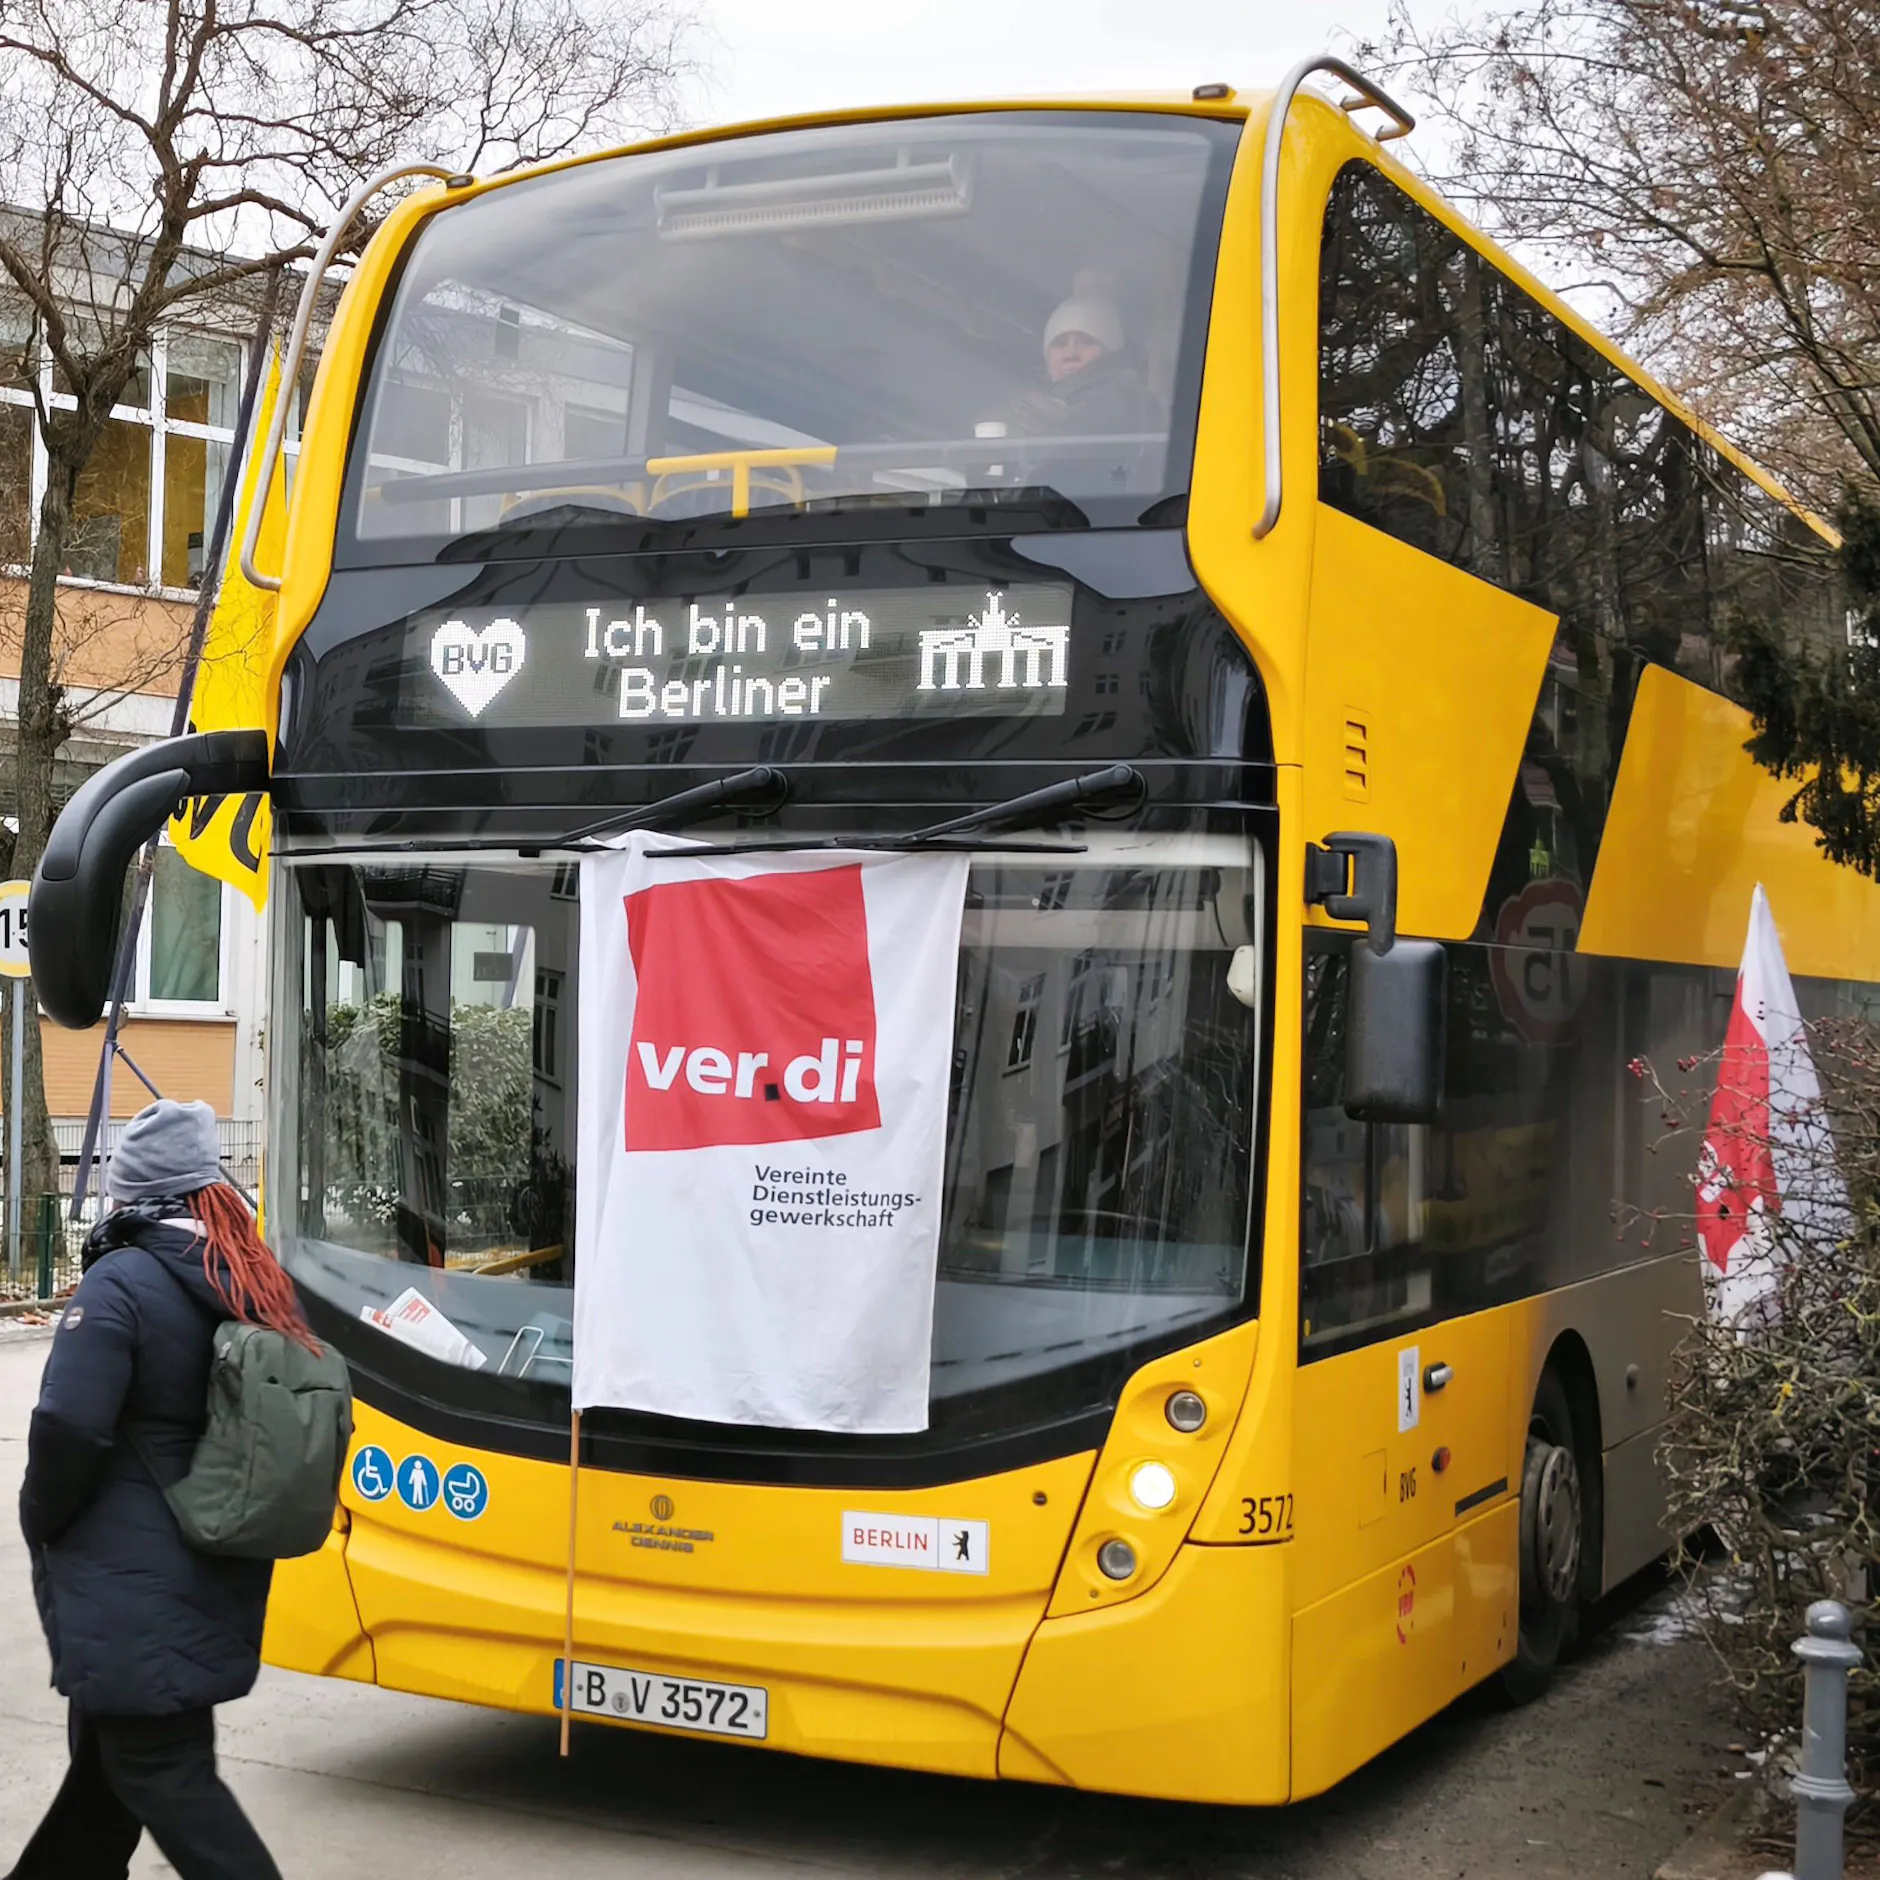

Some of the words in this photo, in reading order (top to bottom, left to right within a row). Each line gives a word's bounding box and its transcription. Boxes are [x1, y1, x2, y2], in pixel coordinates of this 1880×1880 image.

[584, 605, 663, 658] Ich
[688, 602, 767, 655] bin
[793, 597, 871, 651] ein
[442, 642, 513, 675] BVG
[618, 664, 832, 719] Berliner
[636, 1037, 864, 1103] ver.di
[754, 1164, 848, 1187] Vereinte
[752, 1185, 922, 1211] Dienstleistungs-
[750, 1207, 895, 1228] gewerkschaft
[1399, 1466, 1417, 1504] BVG
[1238, 1492, 1294, 1535] 3572
[853, 1527, 929, 1552] BERLIN
[586, 1669, 607, 1707] B
[630, 1676, 652, 1714] V
[660, 1681, 750, 1730] 3572
